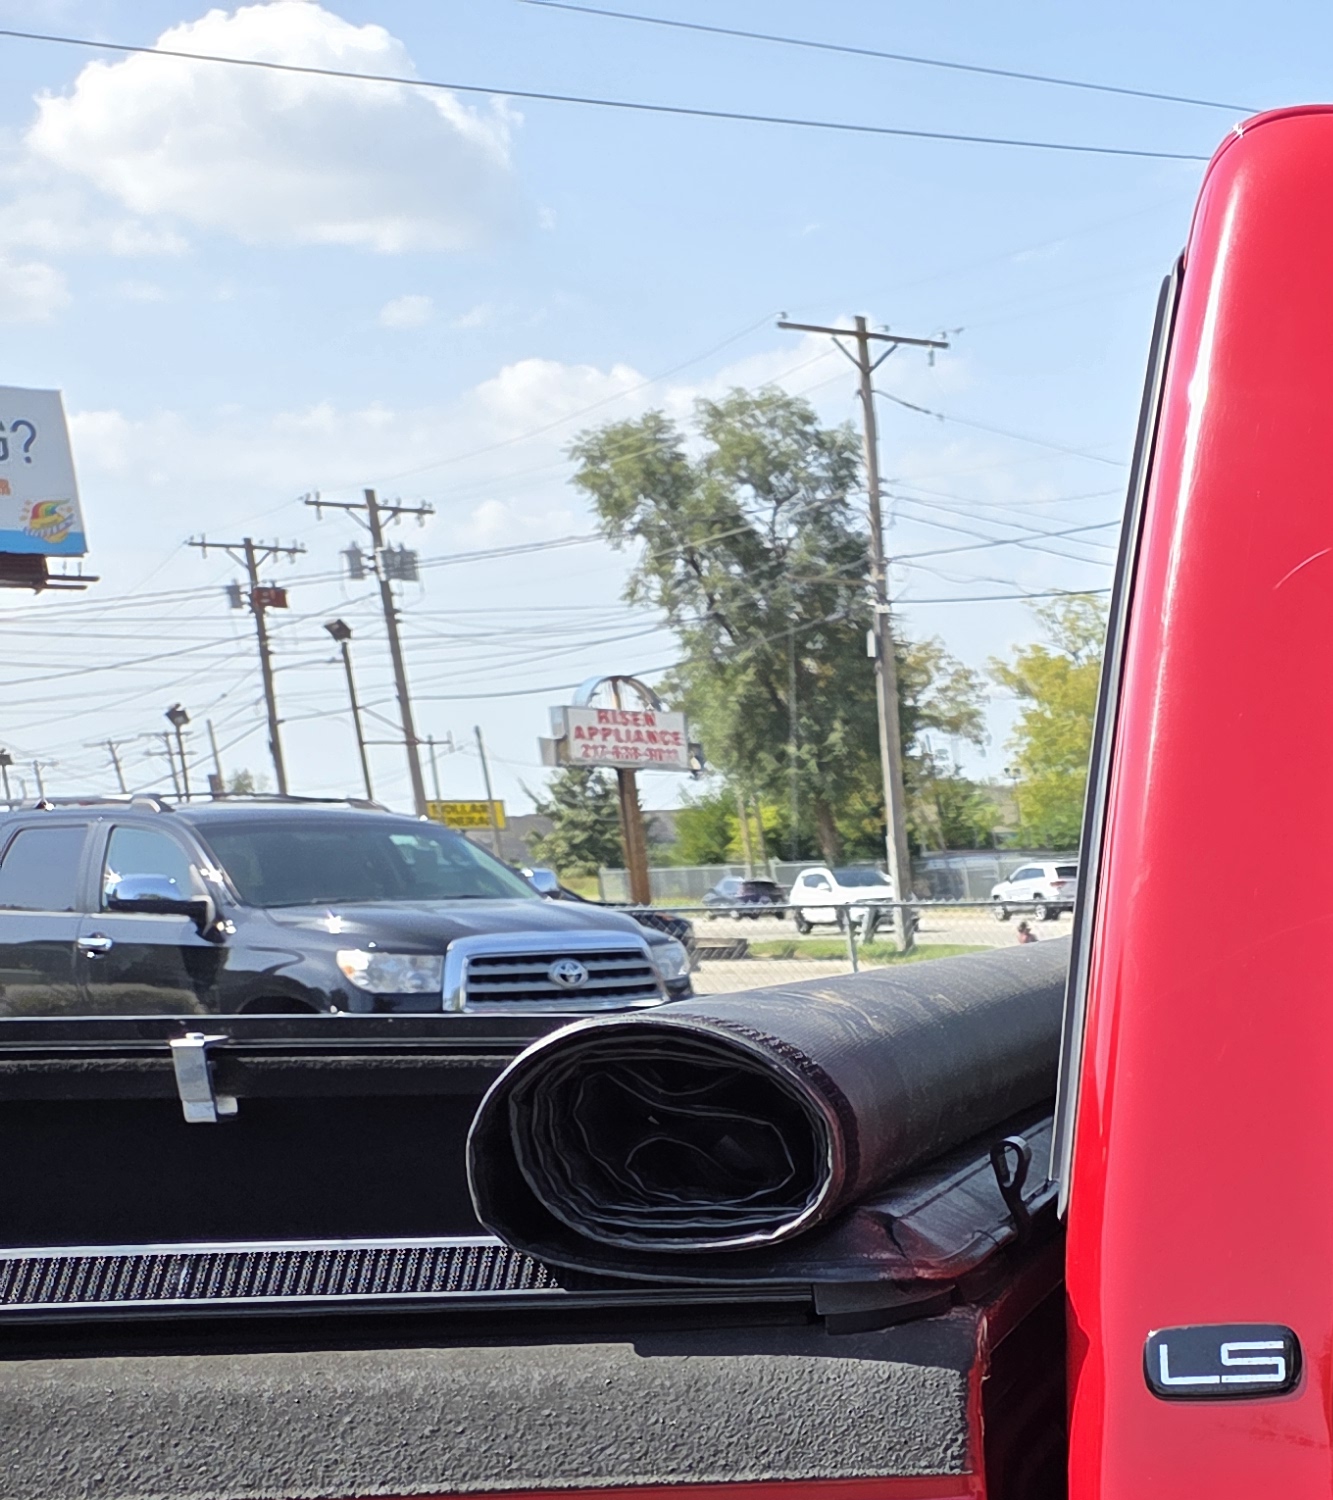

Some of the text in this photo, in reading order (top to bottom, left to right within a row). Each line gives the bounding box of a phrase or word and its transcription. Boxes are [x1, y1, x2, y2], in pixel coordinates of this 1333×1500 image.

[597, 709, 656, 727] RISEN
[574, 726, 684, 746] APPLIANCE
[1159, 1340, 1286, 1385] LS
